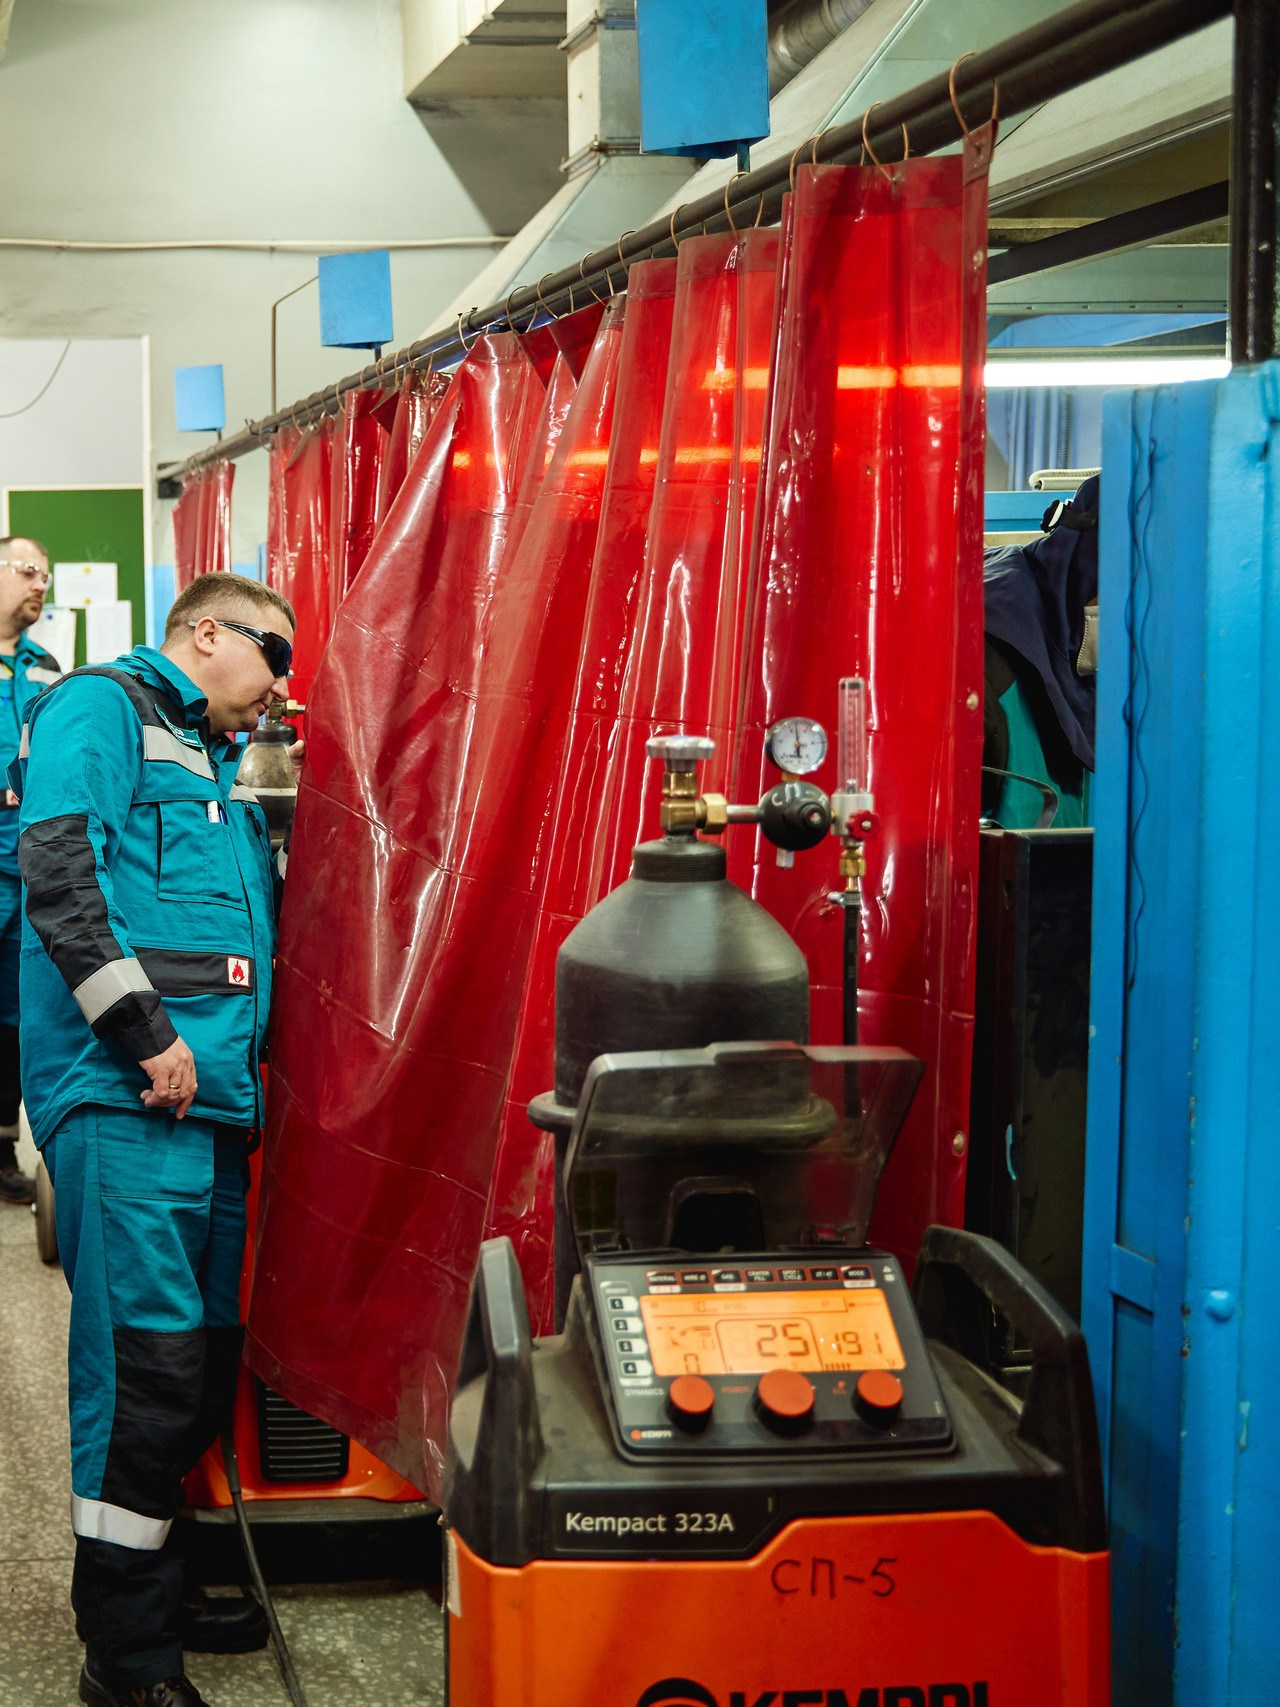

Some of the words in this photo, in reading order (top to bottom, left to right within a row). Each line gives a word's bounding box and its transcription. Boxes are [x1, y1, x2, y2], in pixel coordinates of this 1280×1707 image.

[624, 1387, 665, 1396] DYNAMICS
[565, 1512, 667, 1536] Kempact
[674, 1512, 734, 1532] 323A
[771, 1557, 898, 1599] СП-5
